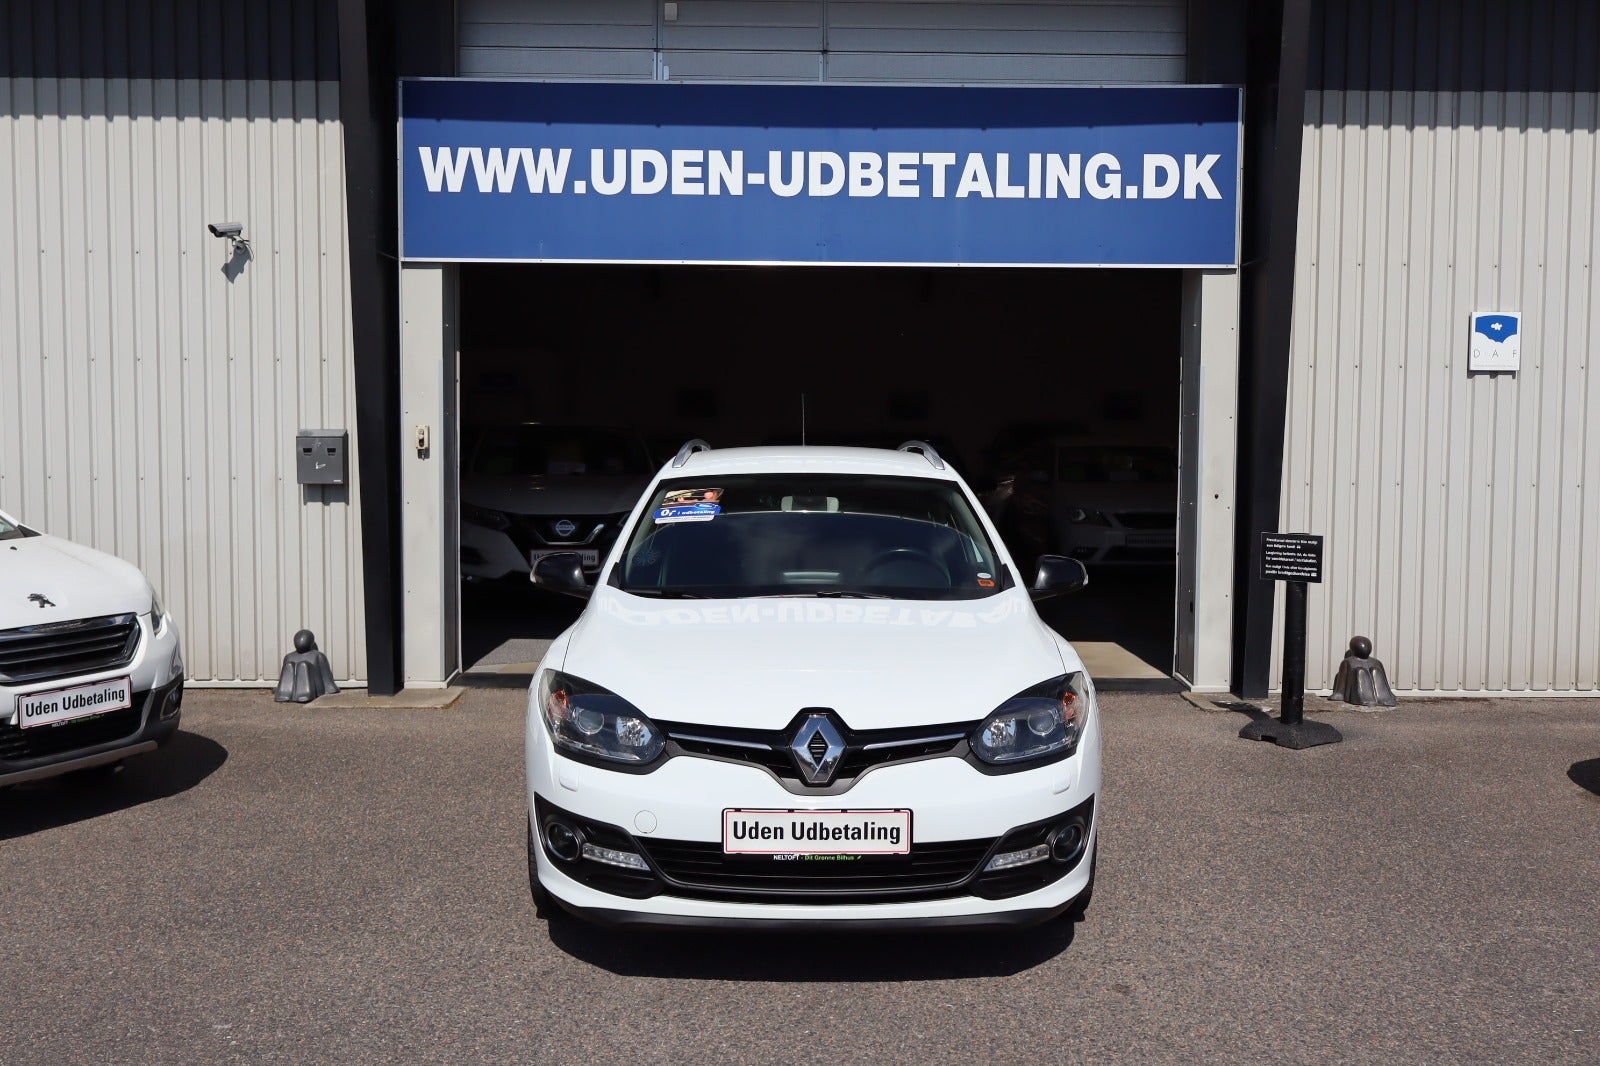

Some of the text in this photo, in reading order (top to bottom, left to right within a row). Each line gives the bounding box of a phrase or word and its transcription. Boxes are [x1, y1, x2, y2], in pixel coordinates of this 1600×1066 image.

[418, 146, 1222, 200] WWW.UDEN-UDBETALING.DK
[25, 688, 125, 718] Uden Udbetaling
[733, 820, 901, 845] Uden Udbetaling
